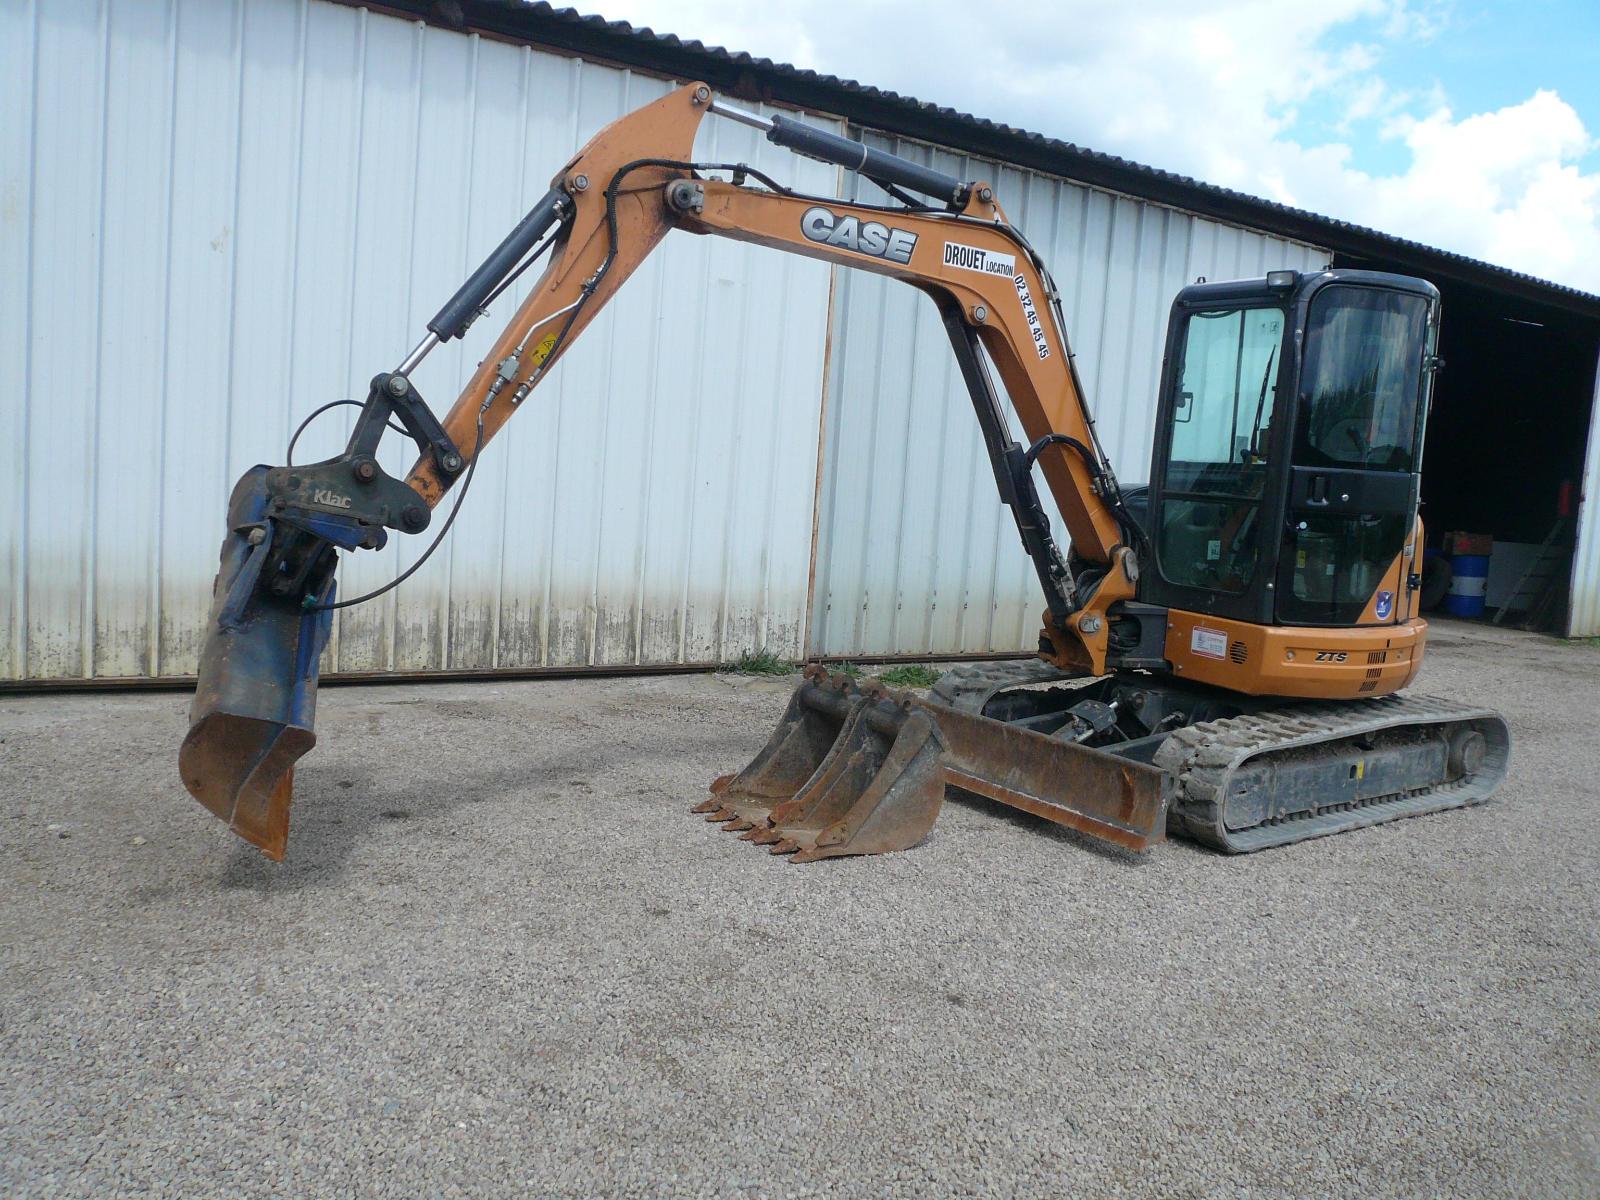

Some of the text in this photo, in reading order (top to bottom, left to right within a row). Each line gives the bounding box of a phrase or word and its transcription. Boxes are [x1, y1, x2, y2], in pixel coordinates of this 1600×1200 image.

[801, 206, 917, 264] CASE
[944, 243, 1014, 277] DROUET LOCATION
[1014, 275, 1049, 359] 02 32 45 45 45
[313, 488, 352, 509] Klac
[1315, 651, 1348, 663] ZTS
